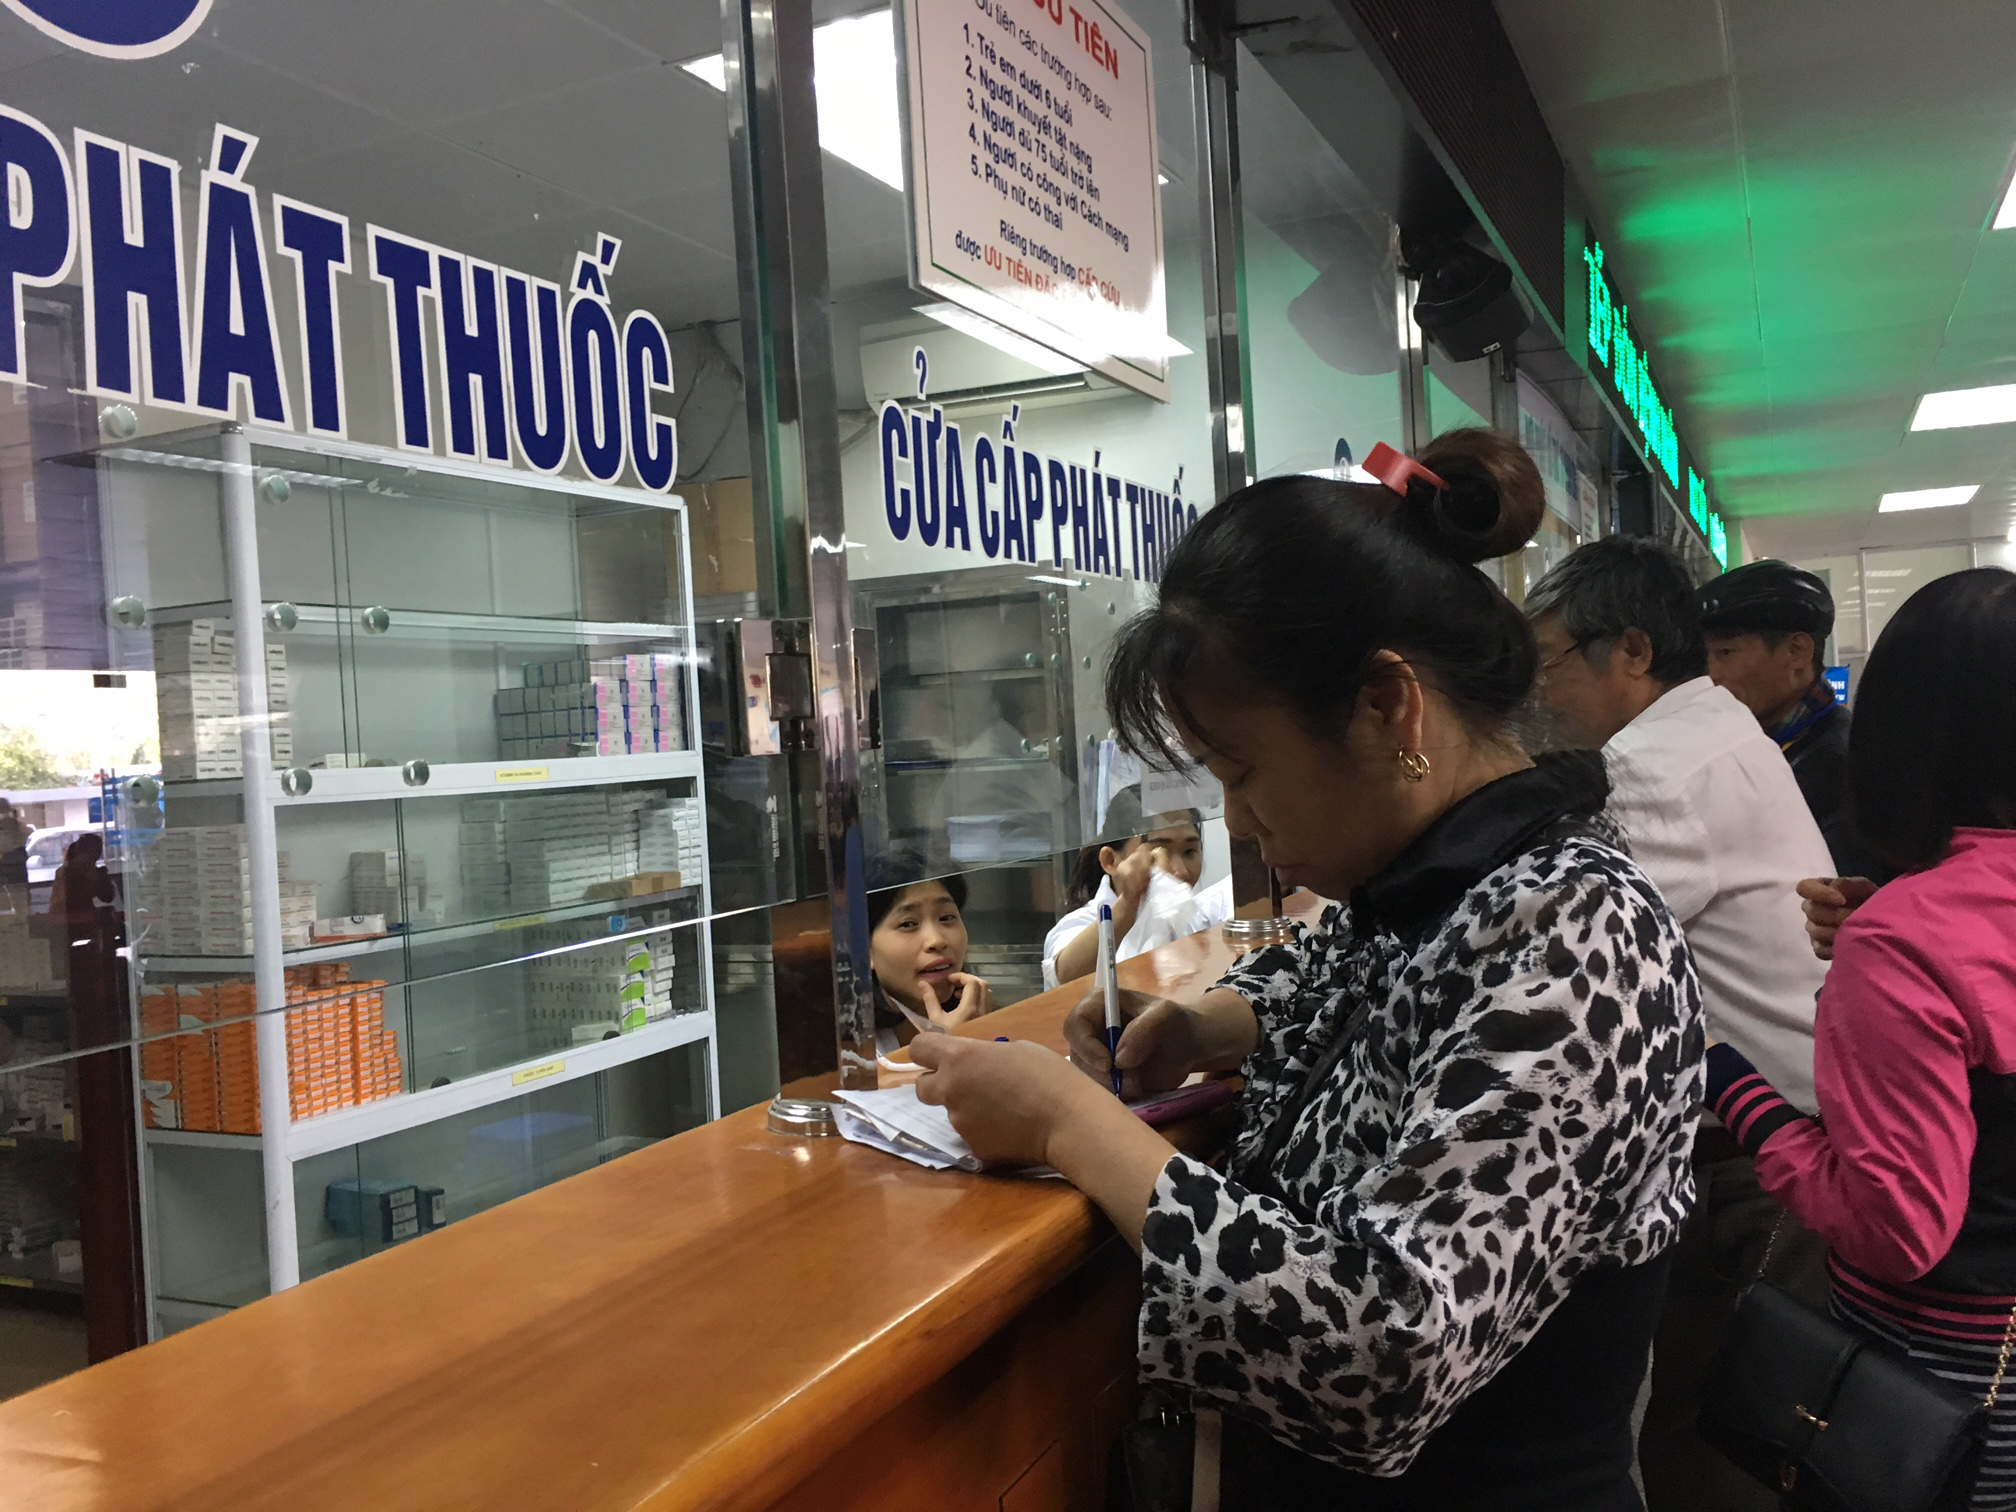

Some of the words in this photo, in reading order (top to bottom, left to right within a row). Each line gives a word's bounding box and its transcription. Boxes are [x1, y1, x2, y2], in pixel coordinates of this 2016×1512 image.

[963, 23, 974, 48] 1.
[977, 32, 996, 65] Trẻ
[999, 56, 1016, 82] em
[1019, 70, 1042, 103] dưới
[1045, 89, 1051, 110] 6
[1053, 96, 1073, 127] tuổi
[995, 4, 1015, 38] tiên
[1019, 28, 1038, 56] các
[1040, 43, 1072, 91] trường
[1075, 72, 1092, 106] hợp
[1069, 5, 1118, 80] TIÊN
[965, 54, 976, 81] 2.
[979, 64, 1014, 110] Người
[1016, 94, 1052, 139] khuyết
[1054, 125, 1067, 152] tật
[1069, 141, 1092, 174] nặng
[966, 87, 978, 114] 3.
[981, 97, 1015, 141] Người
[1019, 127, 1032, 153] đủ
[1034, 138, 1047, 163] 75
[1049, 150, 1068, 179] tuổi
[1071, 165, 1084, 190] trở
[1086, 176, 1100, 202] lên
[968, 122, 980, 146] 4.
[983, 130, 1018, 172] Người
[1020, 161, 1033, 182] có
[1036, 172, 1061, 206] công
[1064, 191, 1078, 213] với
[1080, 199, 1104, 231] Cách
[1105, 220, 1129, 253] mạng
[971, 153, 982, 179] 5.
[985, 162, 1008, 200] Phụ
[1011, 184, 1026, 206] nữ
[1028, 196, 1041, 216] có
[1043, 202, 1063, 231] thai
[955, 230, 981, 261] được
[984, 244, 1002, 271] ƯU
[1005, 256, 1032, 287] TIÊN
[1000, 219, 1027, 256] Riêng
[1029, 238, 1058, 274] trường
[1060, 255, 1076, 283] hợp
[0, 122, 352, 441] PHÁT
[366, 231, 679, 494] THUỐC
[878, 345, 971, 552] CỬA
[974, 400, 1043, 566] CẤP
[1047, 448, 1121, 580] PHÁT
